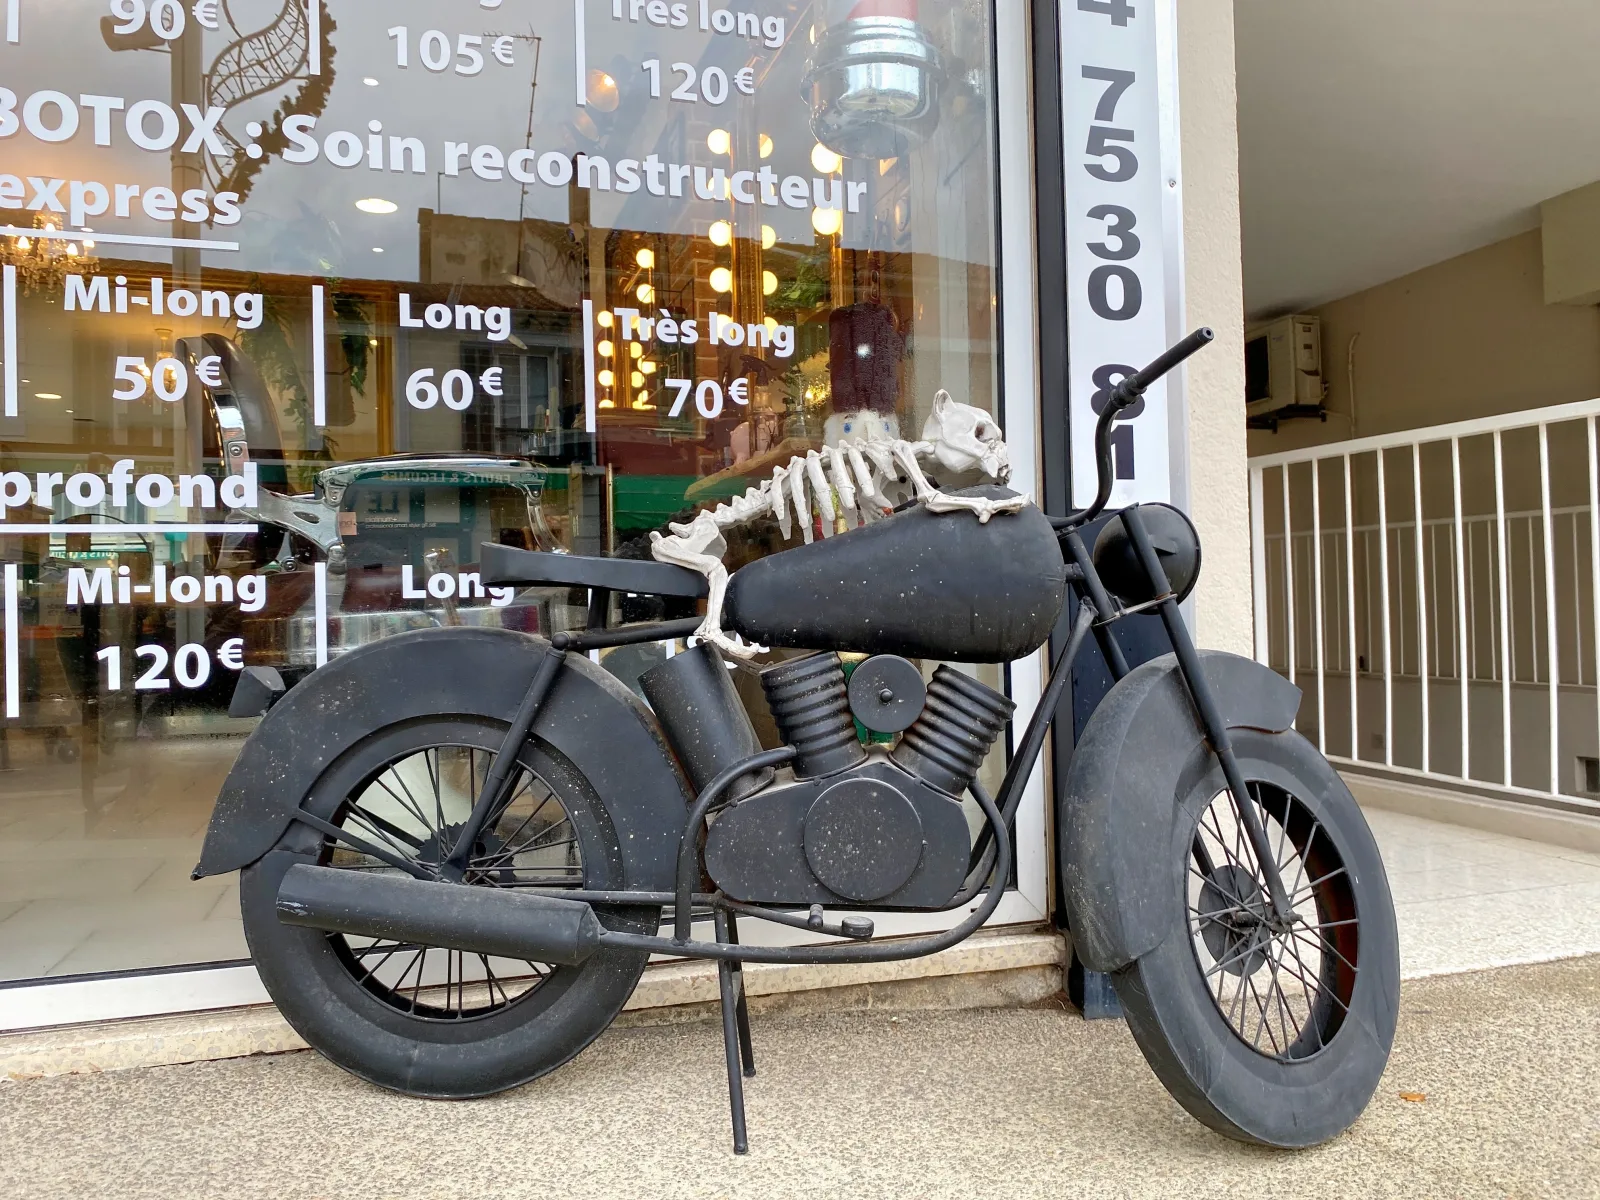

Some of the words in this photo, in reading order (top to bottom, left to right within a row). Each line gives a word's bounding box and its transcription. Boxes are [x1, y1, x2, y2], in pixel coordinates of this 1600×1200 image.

[110, 0, 220, 39] 90€
[699, 0, 785, 48] long
[387, 25, 515, 75] 105€
[641, 58, 755, 105] 120€
[282, 114, 427, 173] Soin
[444, 140, 868, 214] reconstructeur
[0, 173, 242, 227] express
[64, 274, 264, 330] Mi-long
[399, 293, 511, 341] Long
[613, 307, 699, 344] Très
[708, 311, 796, 358] long
[112, 355, 223, 402] 50€
[405, 366, 504, 411] 60€
[664, 377, 750, 419] 70€
[0, 458, 258, 519] profond
[66, 564, 266, 612] Mi-long
[401, 564, 515, 607] Long
[96, 637, 245, 691] 120€
